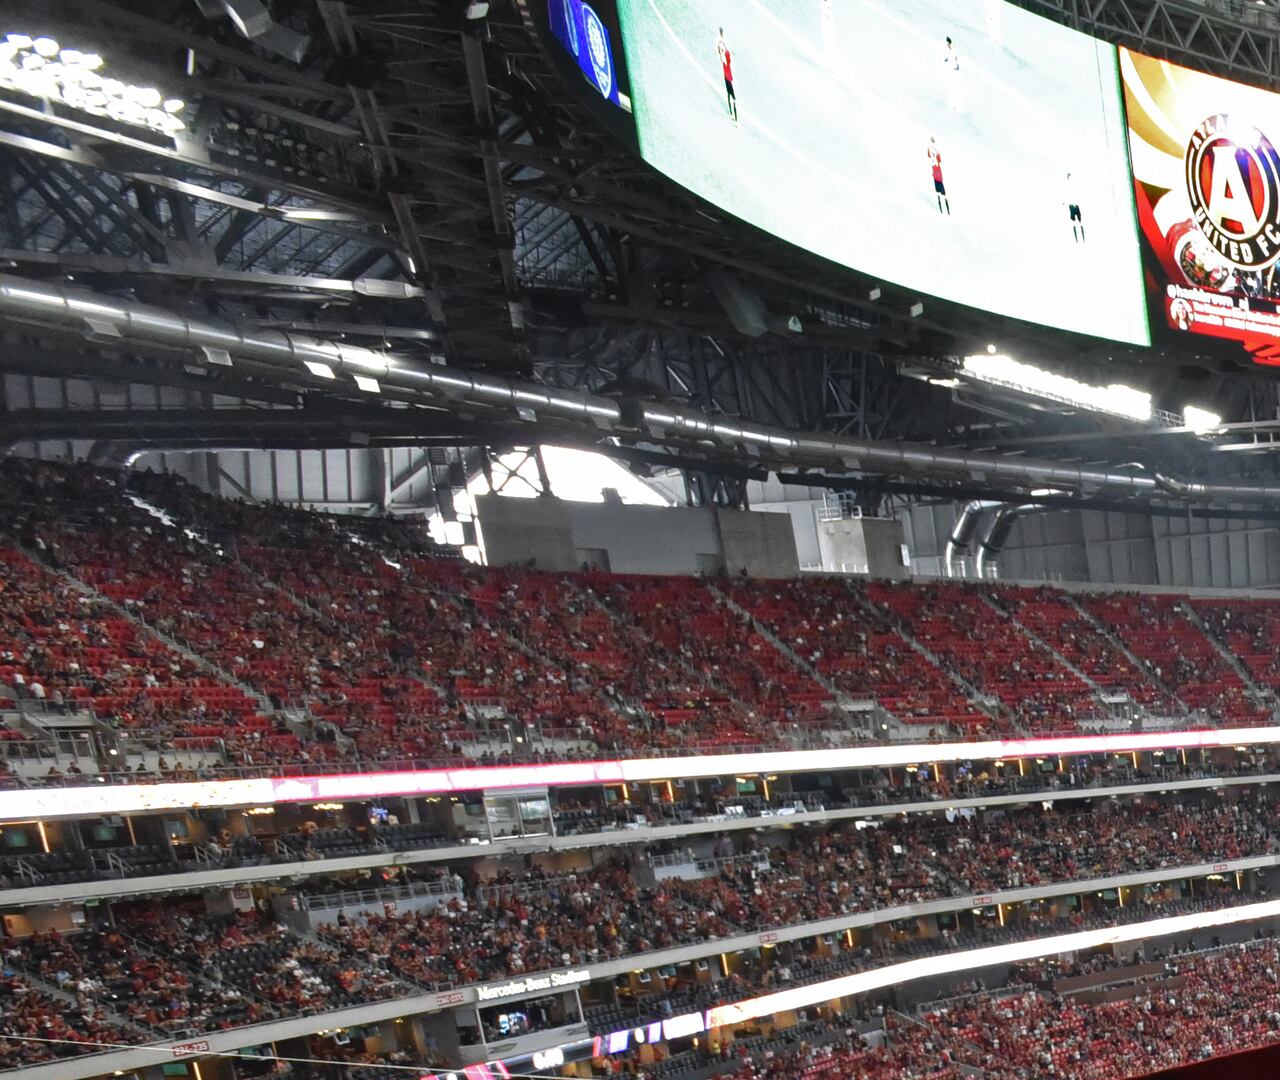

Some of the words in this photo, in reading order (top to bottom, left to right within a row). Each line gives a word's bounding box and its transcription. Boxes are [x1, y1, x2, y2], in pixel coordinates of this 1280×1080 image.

[1208, 144, 1259, 234] A
[1194, 206, 1254, 263] UNITED
[477, 978, 551, 1002] Mercedes-Benz
[551, 969, 591, 986] Stadium
